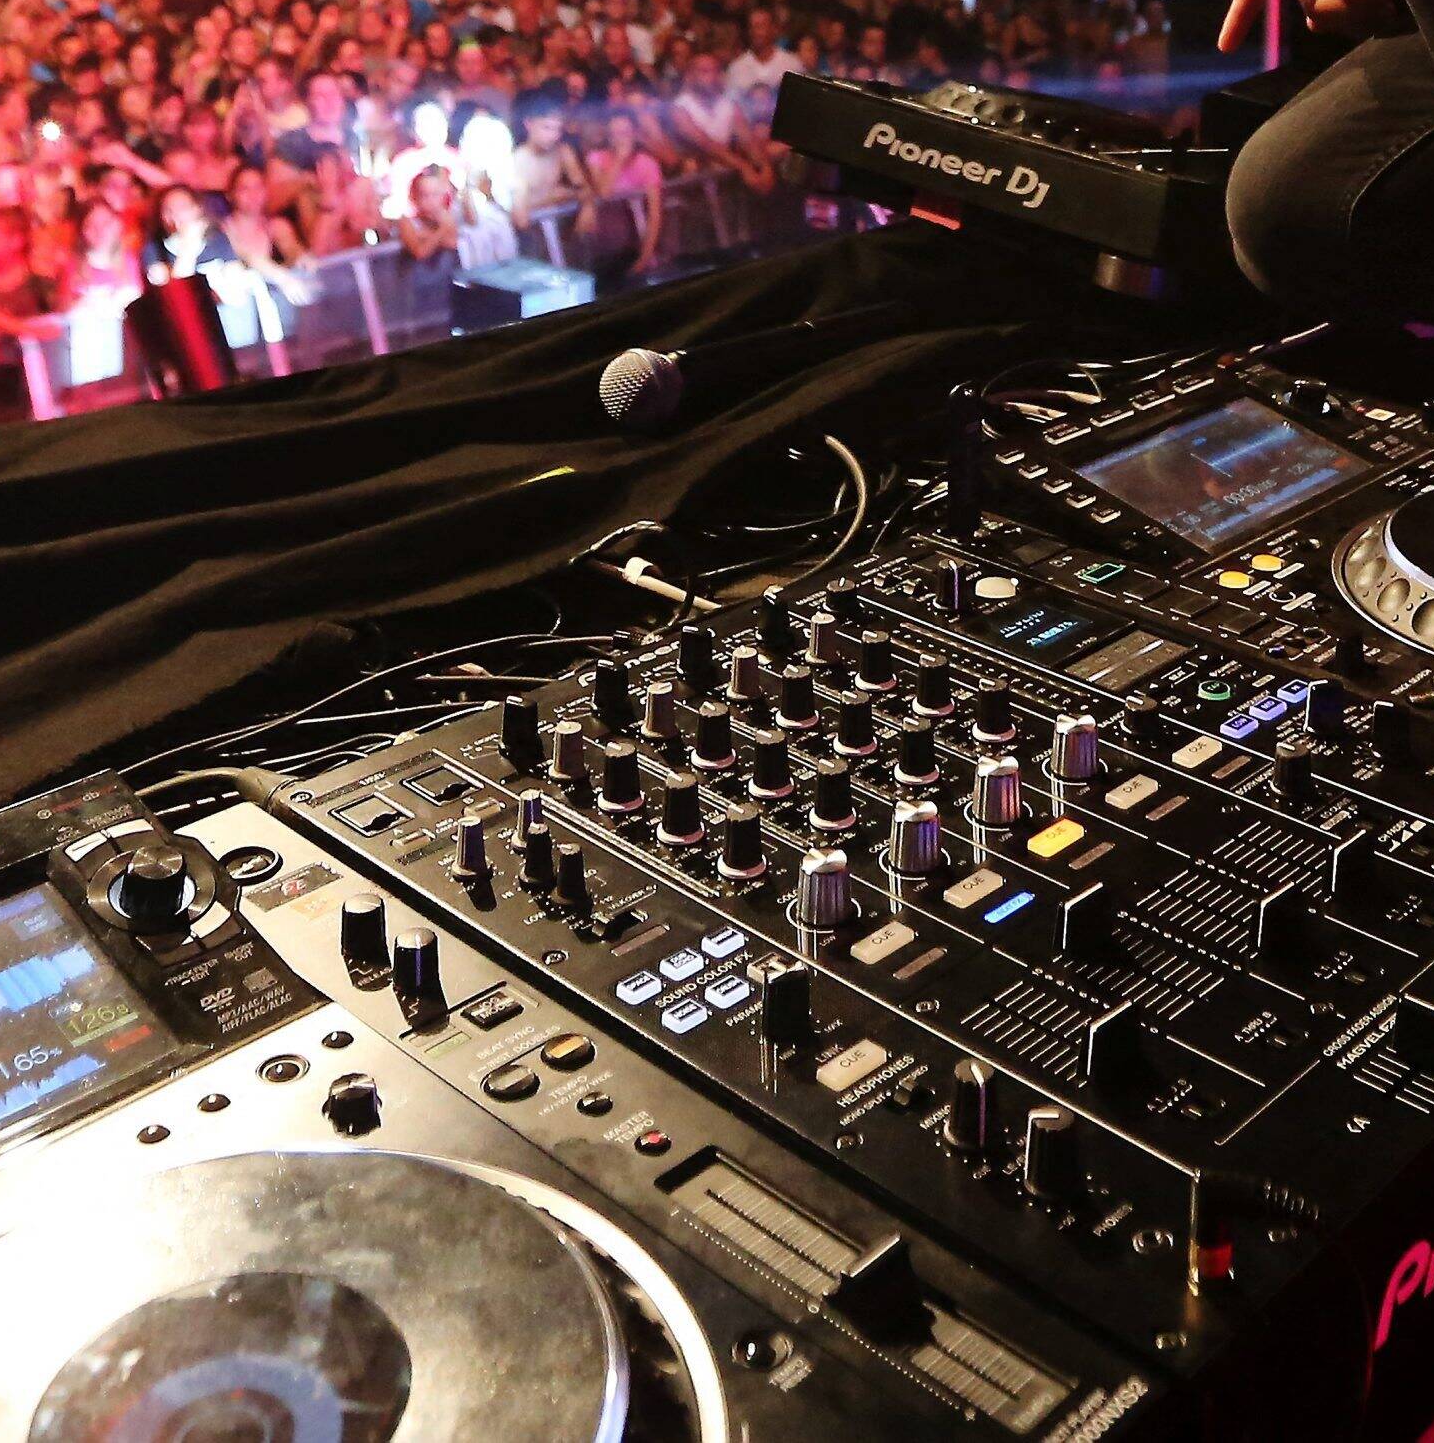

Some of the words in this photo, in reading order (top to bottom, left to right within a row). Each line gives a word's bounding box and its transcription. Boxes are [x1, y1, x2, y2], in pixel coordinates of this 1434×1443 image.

[863, 122, 1002, 186] Pioneer
[1005, 165, 1050, 208] DJ
[962, 875, 985, 891] CUE
[871, 929, 895, 945] CUE
[654, 983, 698, 1009] SOUND
[696, 964, 736, 986] COLOR
[734, 950, 754, 966] FX
[1323, 1031, 1351, 1058] CROSS
[1347, 1015, 1373, 1041] FADER
[1336, 1030, 1383, 1070] MAGVEL
[815, 1043, 845, 1063] LINK
[839, 1049, 866, 1069] CUE
[547, 1074, 589, 1100] TEMPO
[836, 1055, 916, 1108] HEADPHONES
[603, 1110, 653, 1142] MASTER
[839, 1105, 866, 1127] MONO
[613, 1118, 655, 1145] TEMPO
